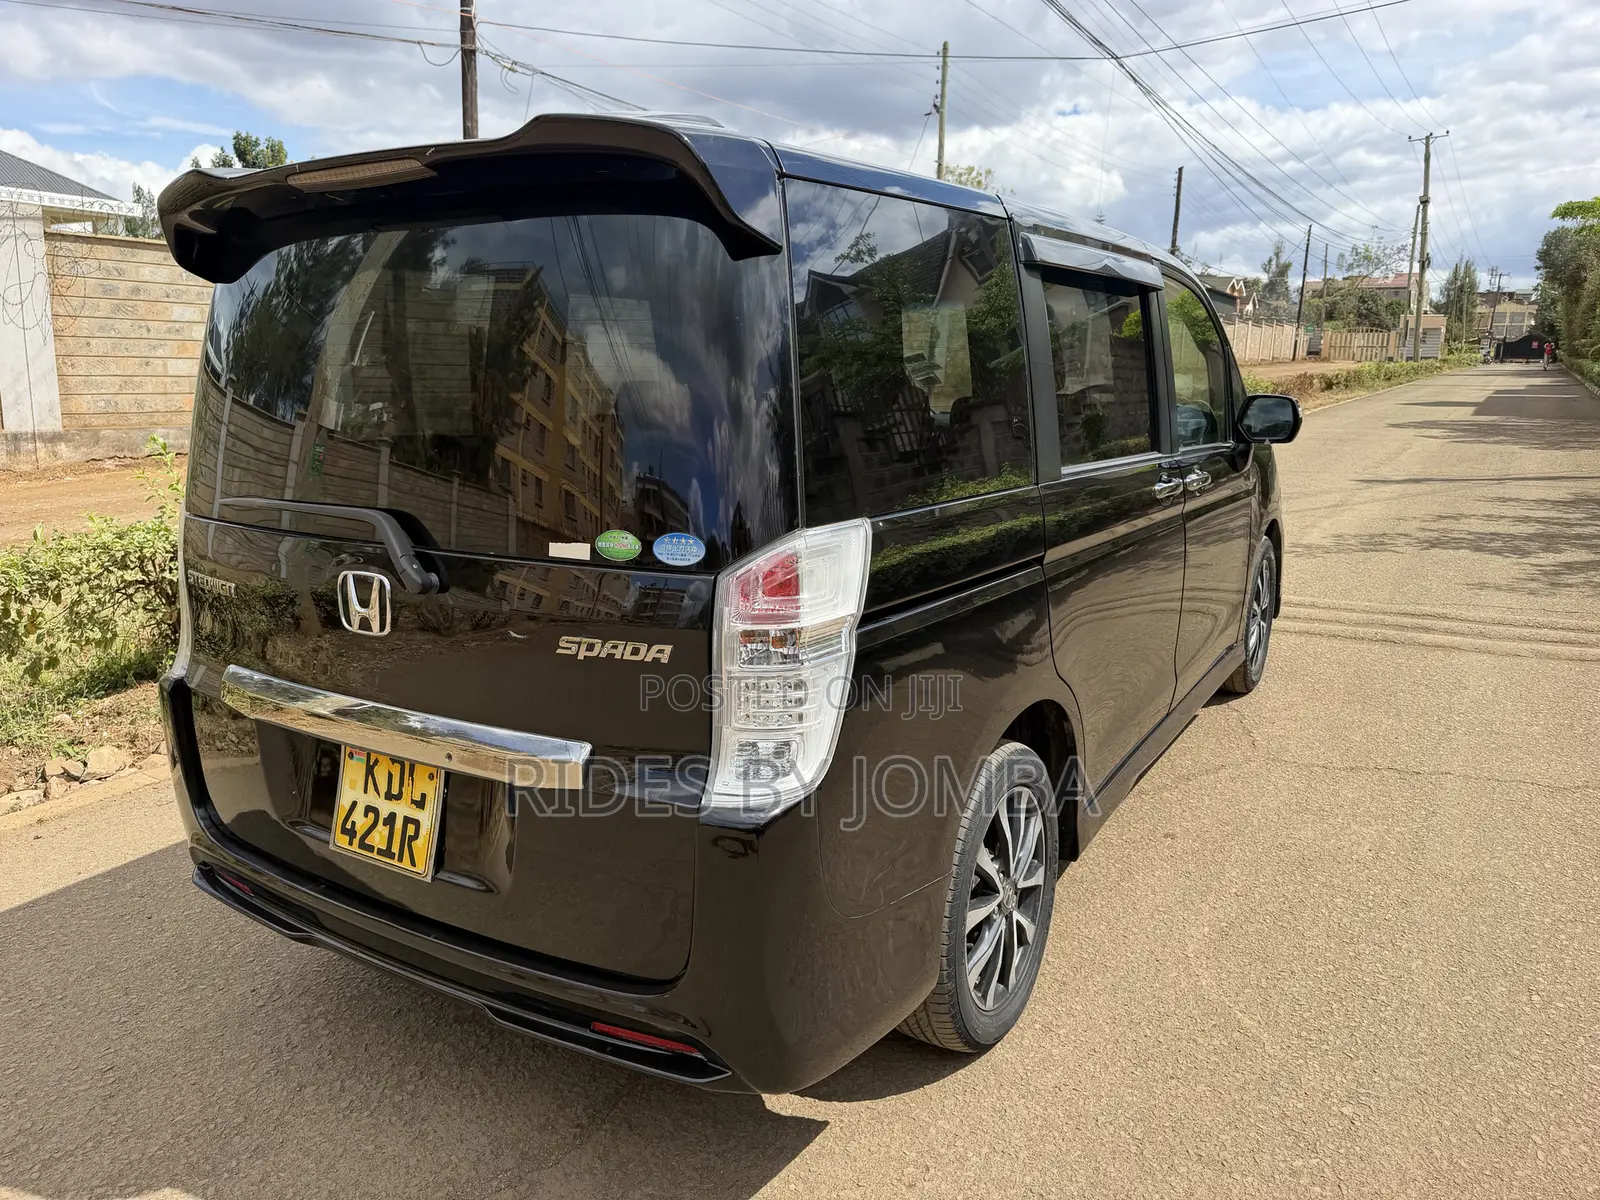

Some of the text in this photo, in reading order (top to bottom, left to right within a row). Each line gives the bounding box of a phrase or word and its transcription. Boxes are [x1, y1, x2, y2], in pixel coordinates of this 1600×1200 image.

[555, 635, 674, 664] SPADA
[363, 751, 428, 811] KDL
[340, 800, 421, 868] 421R
